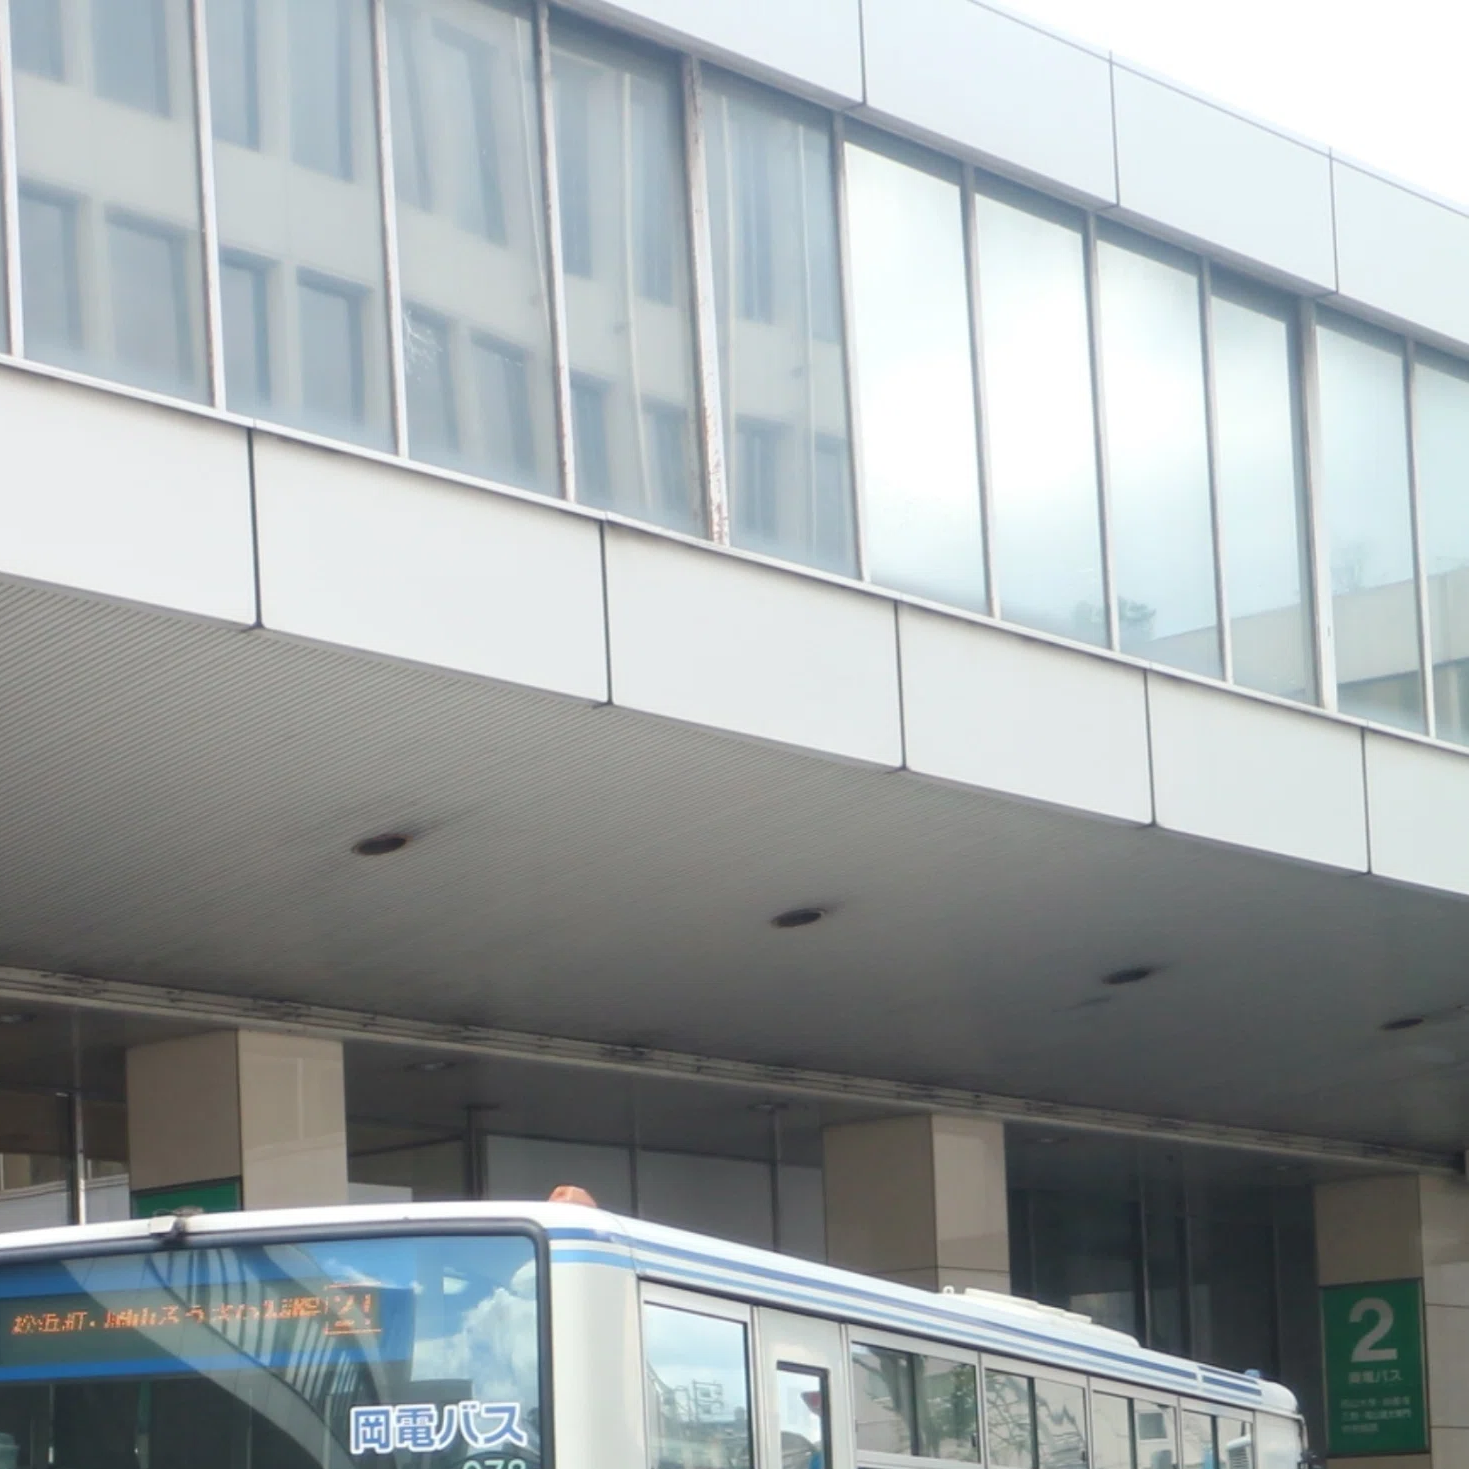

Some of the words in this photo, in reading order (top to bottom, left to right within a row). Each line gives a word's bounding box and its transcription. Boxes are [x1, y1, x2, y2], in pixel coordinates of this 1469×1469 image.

[1349, 1297, 1398, 1363] 2
[350, 1402, 528, 1454] 岡電バス
